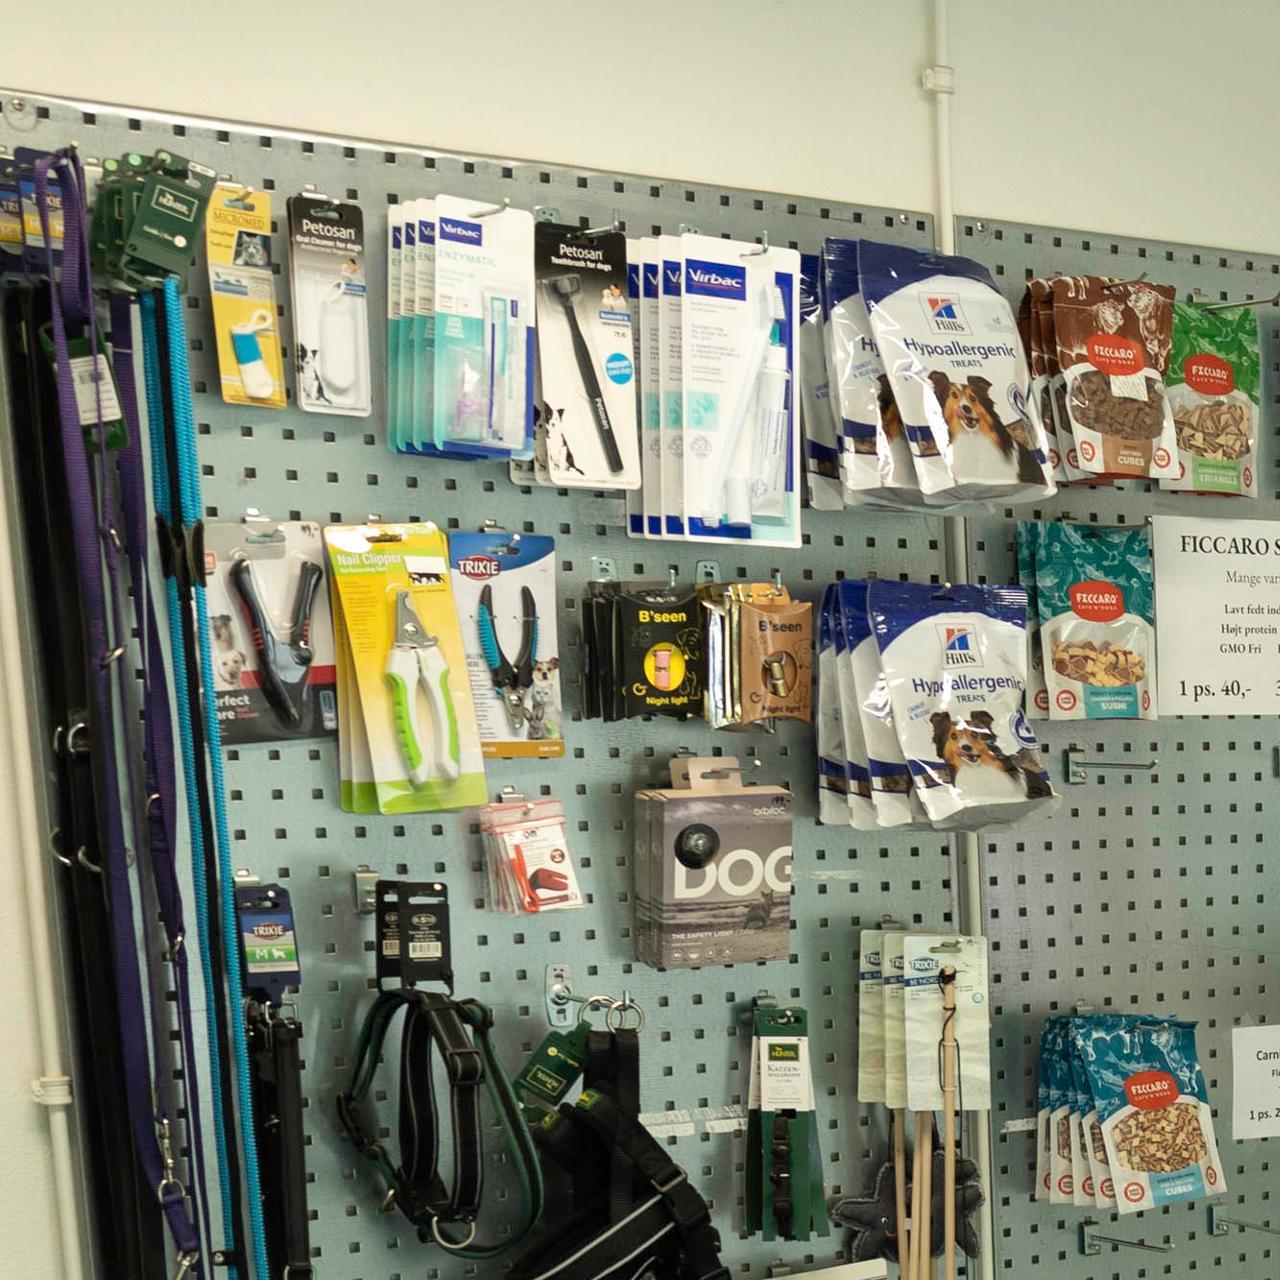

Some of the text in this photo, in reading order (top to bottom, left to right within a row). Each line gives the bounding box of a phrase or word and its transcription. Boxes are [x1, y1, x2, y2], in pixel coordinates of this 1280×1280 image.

[302, 219, 356, 240] Petosan
[442, 222, 481, 238] Virbac
[335, 240, 345, 249] for
[346, 241, 362, 252] dogs
[559, 243, 603, 261] Petosan
[586, 260, 596, 269] for
[596, 261, 612, 272] dogs
[688, 268, 743, 288] Virbac
[904, 338, 1016, 360] Hypoallergenic
[1094, 345, 1135, 359] FICCARO
[950, 359, 983, 369] TREATS
[1192, 365, 1229, 380] FICCARO
[1117, 455, 1145, 467] CUBES
[1180, 534, 1269, 555] FICCARO
[337, 552, 401, 566] Nail Clipper
[458, 558, 499, 576] TRIXIE
[1226, 570, 1262, 587] Mange
[1076, 592, 1117, 604] FICCARO
[1224, 604, 1245, 615] Lavt
[1246, 604, 1265, 615] fedt
[1221, 623, 1242, 637] Højt
[1244, 625, 1277, 637] protein
[1220, 644, 1246, 655] GMO
[1248, 644, 1262, 655] Fri
[946, 652, 977, 666] Hill's
[1179, 680, 1187, 696] 1
[1193, 684, 1216, 702] ps.
[1221, 680, 1252, 699] 40,-
[646, 696, 689, 706] Night light
[956, 694, 987, 704] TREATS
[753, 806, 787, 817] orbiloc
[255, 948, 268, 959] M
[909, 959, 939, 972] TRIXIE
[1131, 1079, 1170, 1095] FICCARO
[1257, 1110, 1273, 1122] ps.
[1164, 1184, 1194, 1197] CUBES
